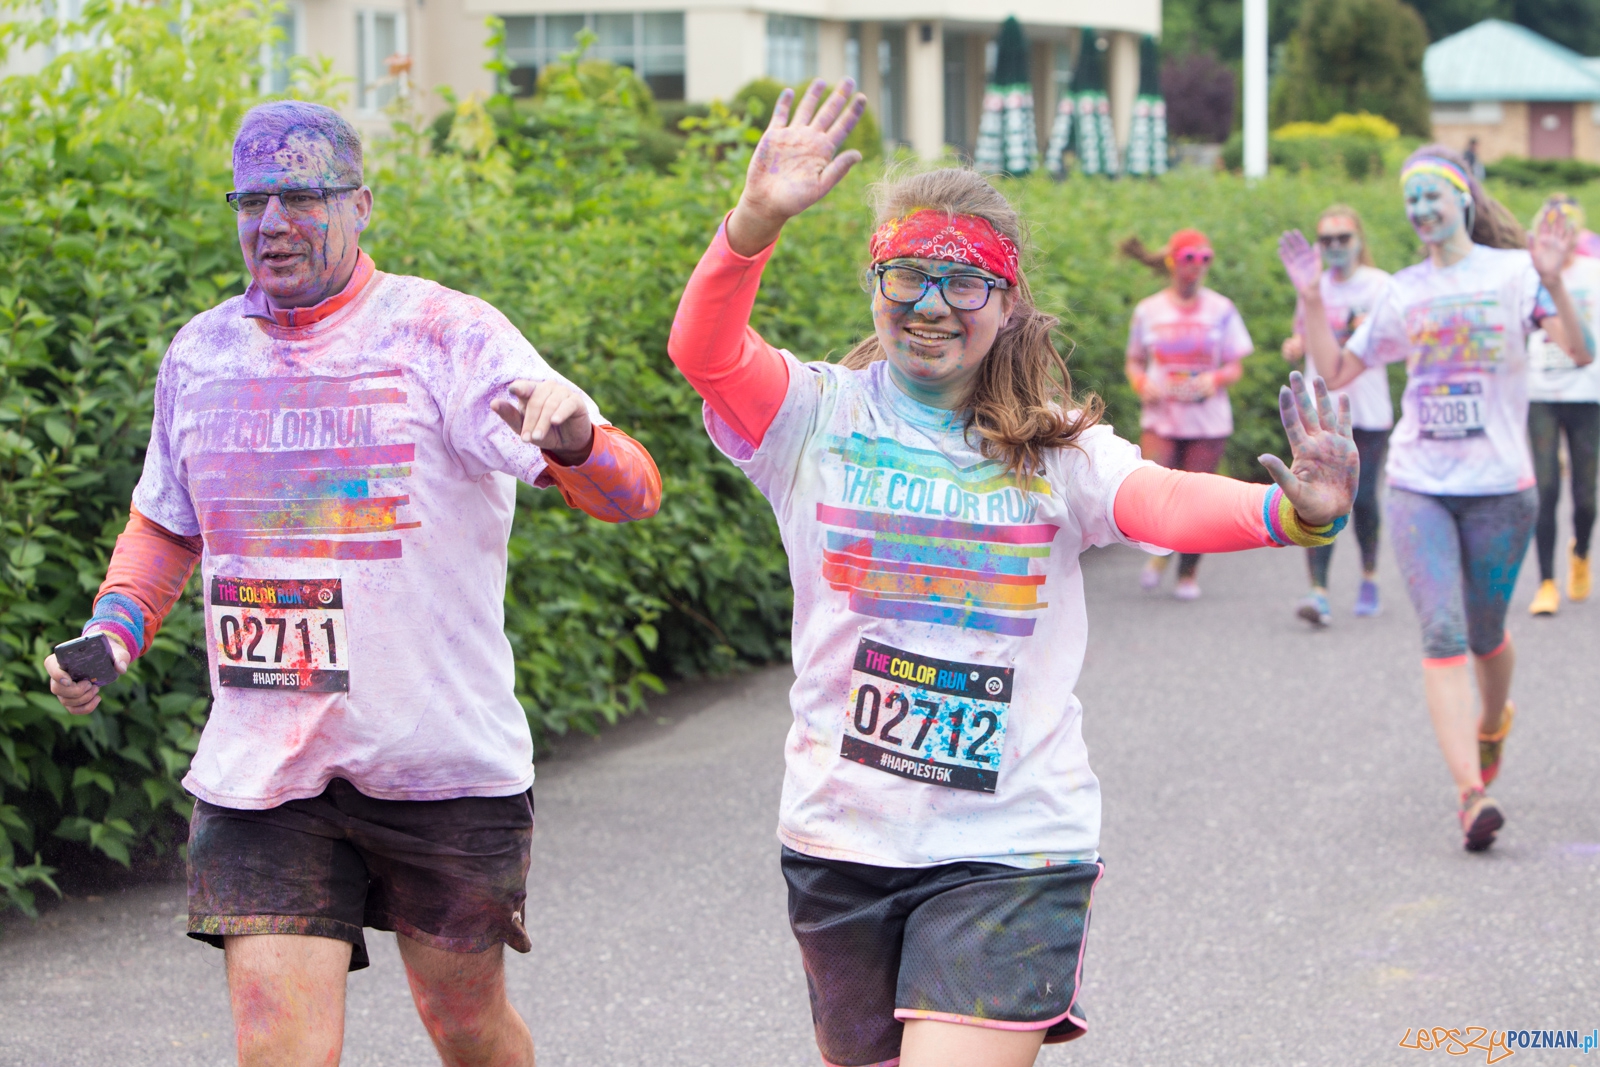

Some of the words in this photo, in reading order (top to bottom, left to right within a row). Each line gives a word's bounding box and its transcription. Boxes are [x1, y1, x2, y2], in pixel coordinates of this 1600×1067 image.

[234, 409, 317, 449] COLOR
[320, 407, 372, 447] RUN
[1419, 401, 1479, 425] 02081
[841, 464, 885, 507] THE
[886, 472, 980, 521] COLOR
[986, 488, 1040, 524] RUN
[218, 584, 238, 601] THE
[239, 586, 276, 604] COLOR
[220, 615, 337, 664] 02711
[865, 649, 891, 673] THE
[890, 657, 937, 686] COLOR
[854, 683, 998, 763] 02712
[880, 752, 953, 783] #HAPPIEST5K
